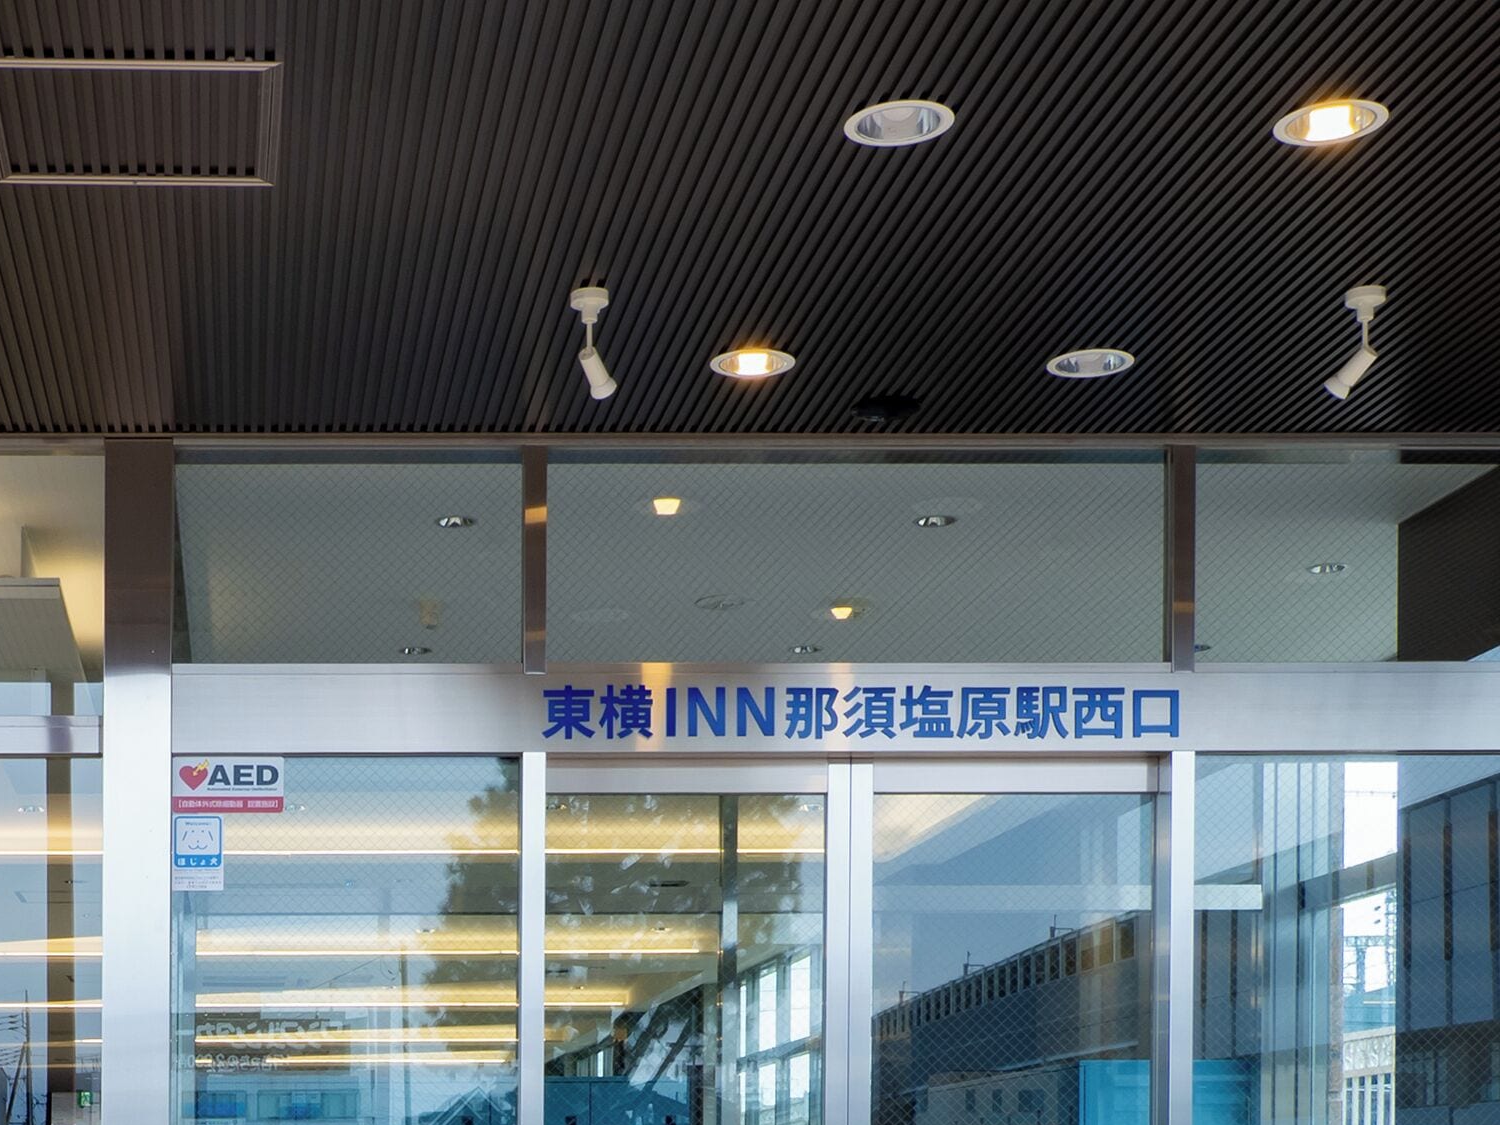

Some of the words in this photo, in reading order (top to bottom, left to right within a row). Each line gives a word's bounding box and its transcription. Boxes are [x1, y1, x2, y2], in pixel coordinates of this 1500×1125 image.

[542, 684, 1180, 740] 東横INN那須塩原駅西口
[206, 764, 279, 786] AED
